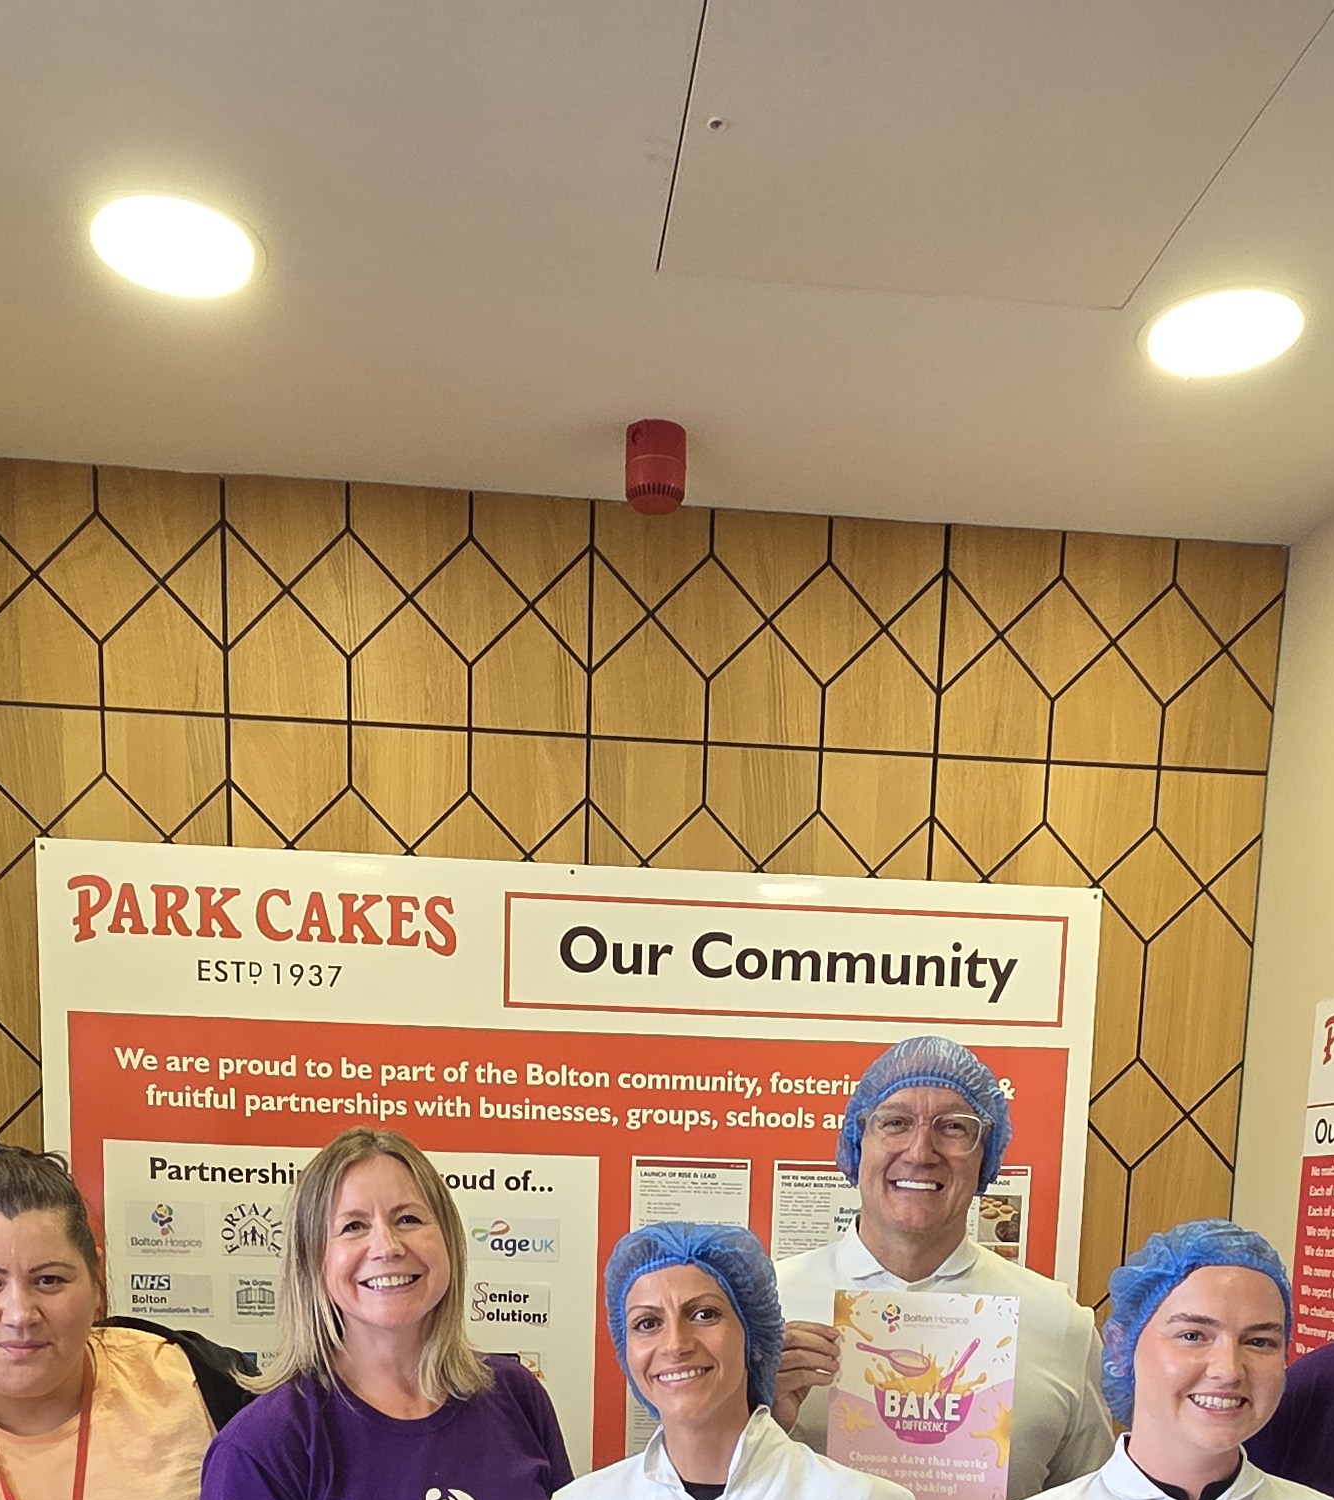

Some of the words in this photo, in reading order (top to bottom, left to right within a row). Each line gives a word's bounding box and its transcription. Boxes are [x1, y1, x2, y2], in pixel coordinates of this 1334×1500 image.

[67, 875, 241, 942] PARK
[256, 889, 457, 957] CAKES
[273, 963, 343, 988] 1937
[559, 926, 673, 976] Our
[692, 932, 1018, 1003] Community
[114, 1046, 158, 1072] We
[166, 1054, 210, 1073] are
[218, 1054, 297, 1080] proud
[305, 1058, 333, 1079] to
[340, 1057, 373, 1080] be
[380, 1062, 435, 1086] part
[442, 1061, 470, 1083] of
[475, 1062, 518, 1086] the
[525, 1063, 610, 1088] Bolton
[617, 1071, 763, 1100] community,
[998, 1078, 1015, 1100] &
[146, 1084, 236, 1110] fruitful
[245, 1092, 408, 1121] partnerships
[415, 1094, 471, 1118] with
[479, 1101, 619, 1127] businesses,
[626, 1107, 719, 1131] groups,
[726, 1106, 815, 1130] schools
[149, 1157, 301, 1185] Partnershi
[441, 1168, 495, 1190] oud
[505, 1170, 554, 1193] of...
[130, 1236, 164, 1247] Bolton
[131, 1274, 170, 1290] NHS
[474, 1282, 530, 1304] Senior
[131, 1294, 168, 1305] Bolton
[470, 1300, 548, 1324] Solutions
[903, 1313, 933, 1324] Bolton
[934, 1314, 969, 1326] Hospice
[884, 1388, 962, 1422] BAKE
[895, 1421, 901, 1430] A
[902, 1420, 948, 1433] DIFFERENCE
[849, 1451, 888, 1464] Choose
[890, 1456, 898, 1464] a
[899, 1453, 925, 1466] date
[927, 1455, 951, 1468] that
[952, 1457, 989, 1470] works
[895, 1467, 933, 1480] spread
[935, 1469, 954, 1481] the
[955, 1472, 985, 1483] word
